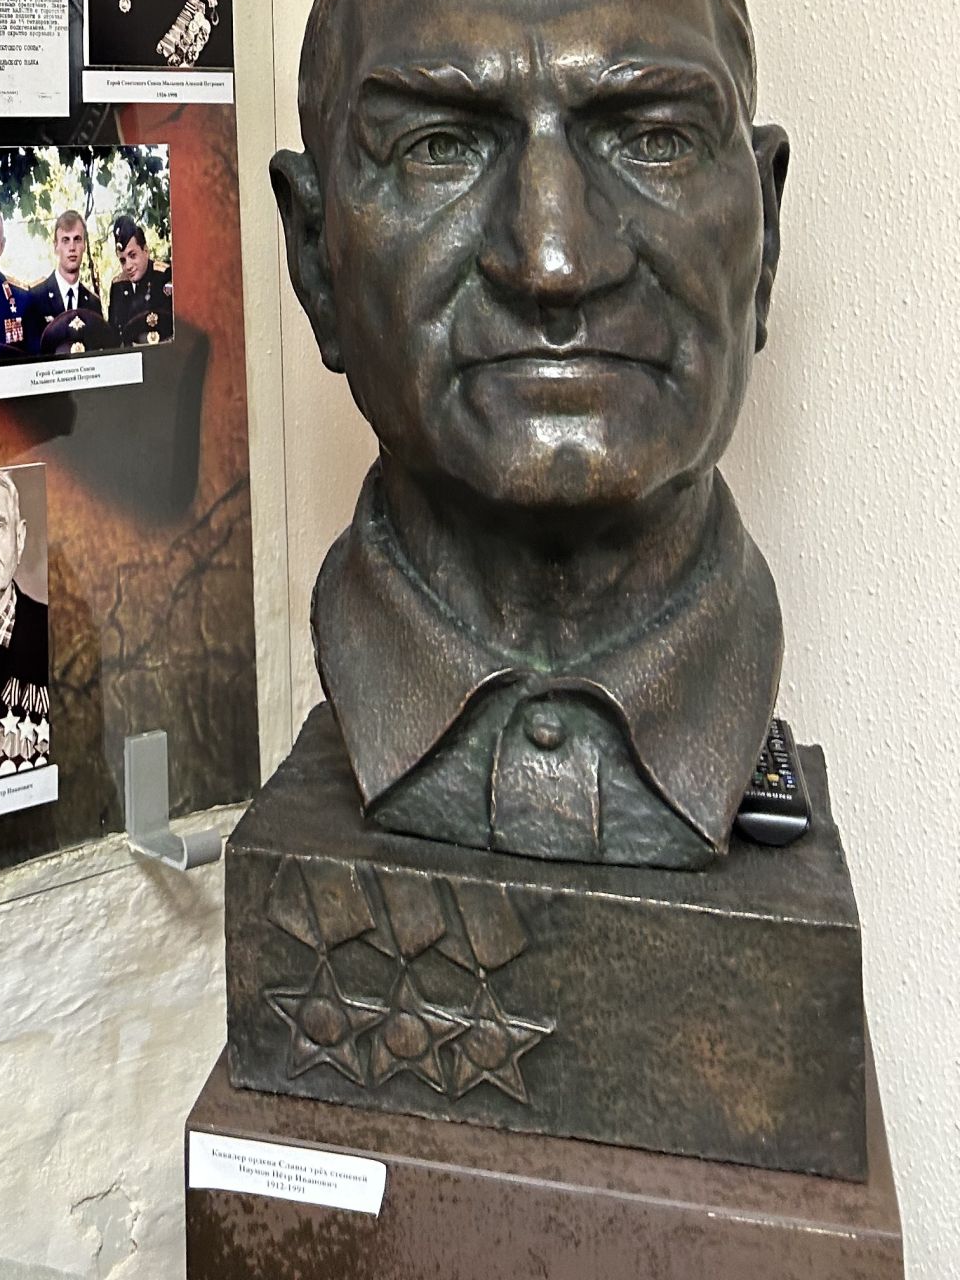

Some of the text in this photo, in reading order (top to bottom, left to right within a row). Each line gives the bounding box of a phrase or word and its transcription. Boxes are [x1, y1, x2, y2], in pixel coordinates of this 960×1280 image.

[211, 1148, 246, 1162] Кавалер
[248, 1157, 276, 1166] ордена
[278, 1160, 306, 1172] Славы
[329, 1171, 367, 1182] степеней
[238, 1163, 269, 1176] Наумов
[295, 1174, 336, 1188] Иванович
[266, 1180, 304, 1193] 1912-1991
